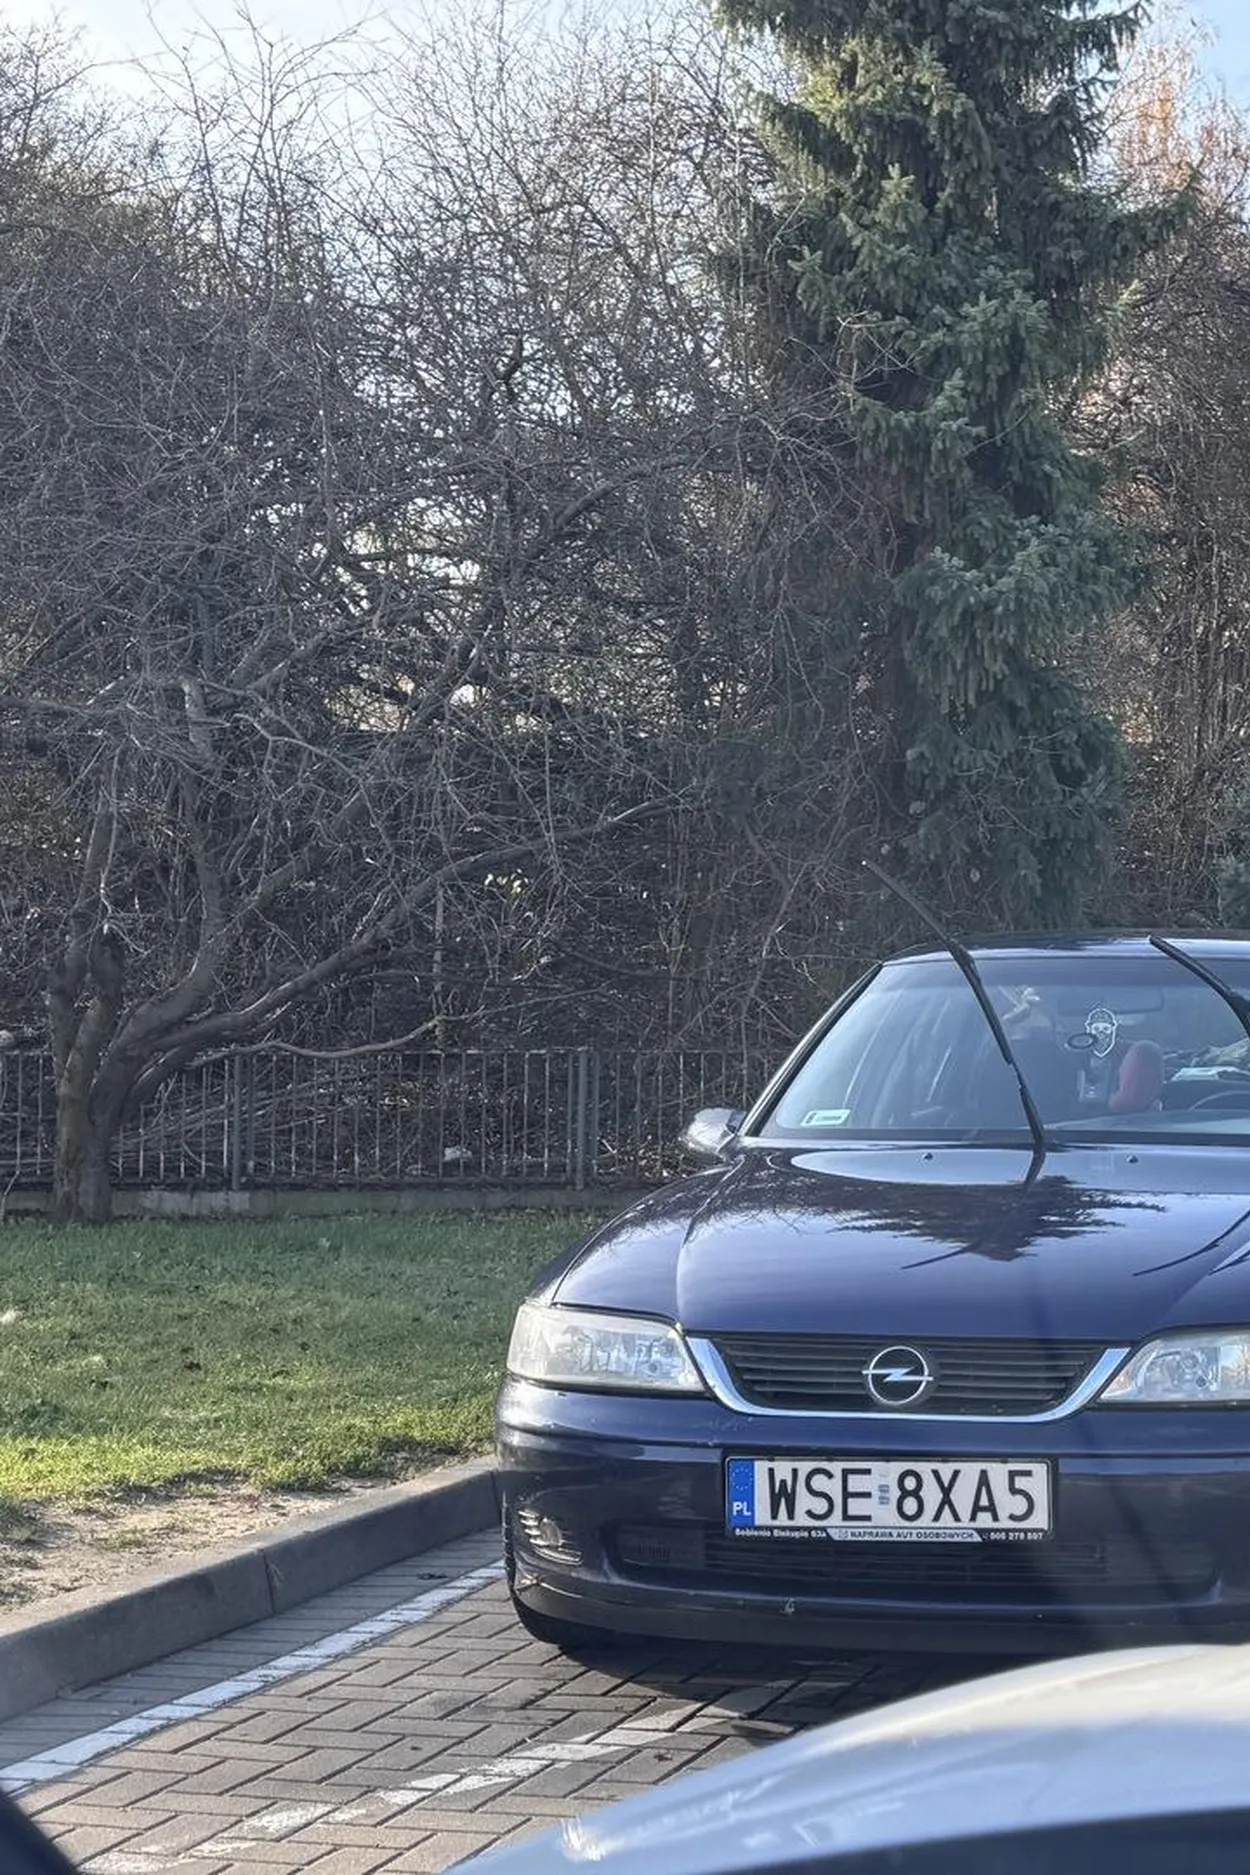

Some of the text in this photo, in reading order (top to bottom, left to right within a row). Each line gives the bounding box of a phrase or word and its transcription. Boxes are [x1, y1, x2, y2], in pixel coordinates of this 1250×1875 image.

[767, 1466, 1037, 1523] WSE 8XA5
[732, 1501, 752, 1516] PL
[895, 1530, 914, 1539] AUT
